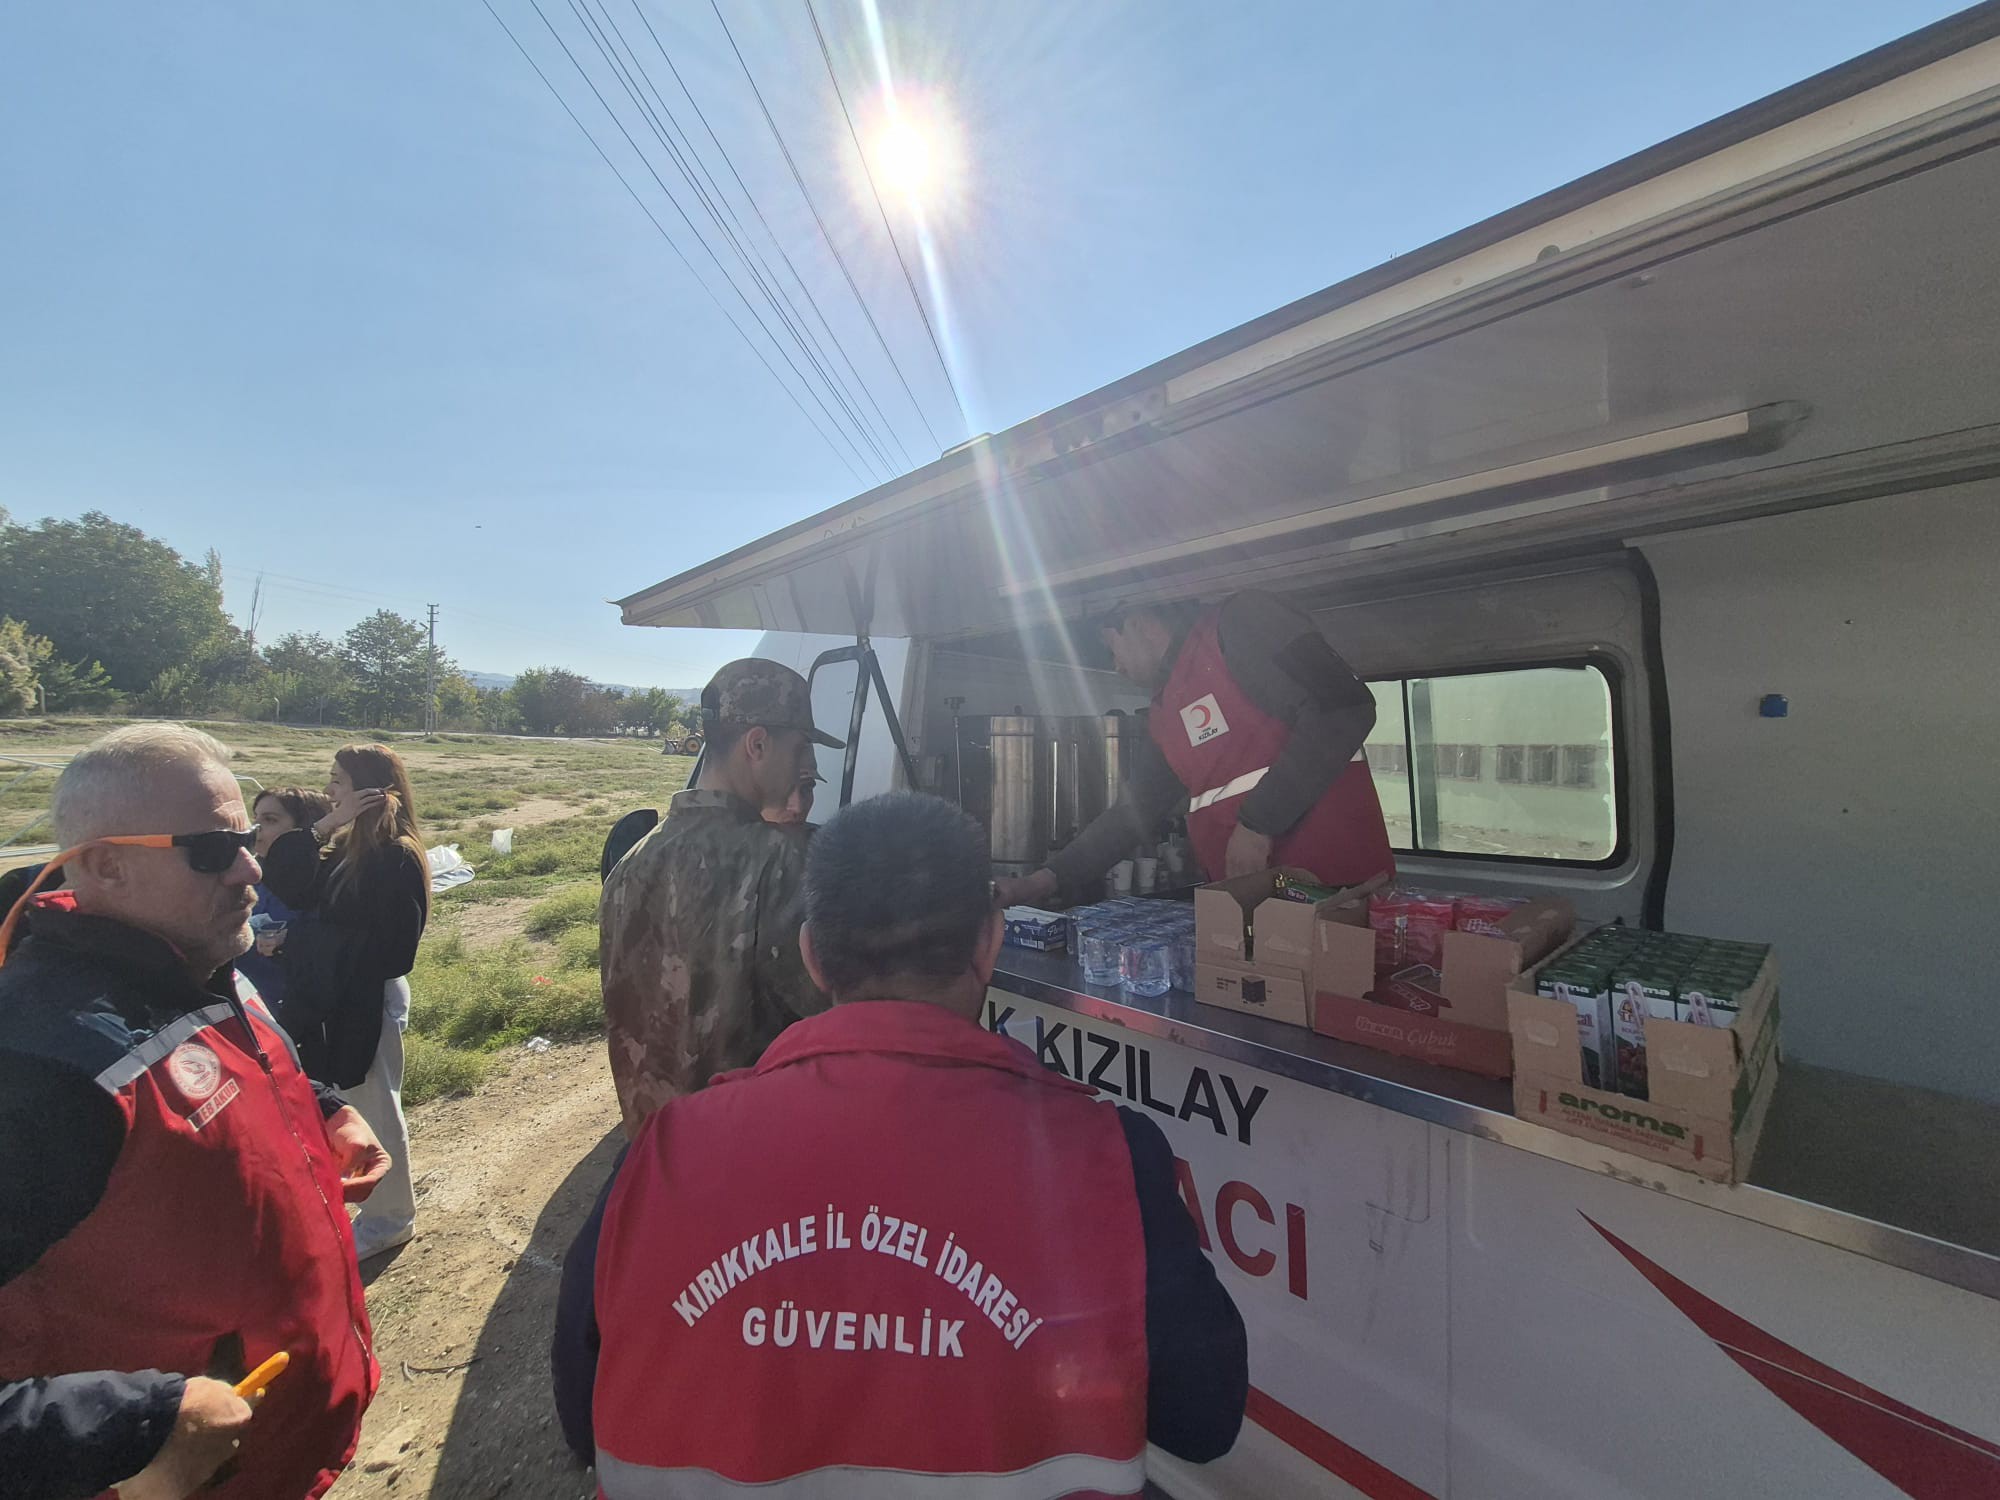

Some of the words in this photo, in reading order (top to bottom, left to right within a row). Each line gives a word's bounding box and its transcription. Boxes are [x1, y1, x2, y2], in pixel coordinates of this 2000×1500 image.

[213, 1082, 238, 1109] AKUB
[1036, 1016, 1269, 1146] KIZILAY
[1558, 1092, 1685, 1139] aroma
[672, 1215, 817, 1328] KIRIKKALE
[826, 1203, 851, 1250] İL
[860, 1205, 928, 1267] ÖZEL
[934, 1231, 1043, 1350] İDARESİ
[742, 1300, 965, 1358] GÜVENLİK
